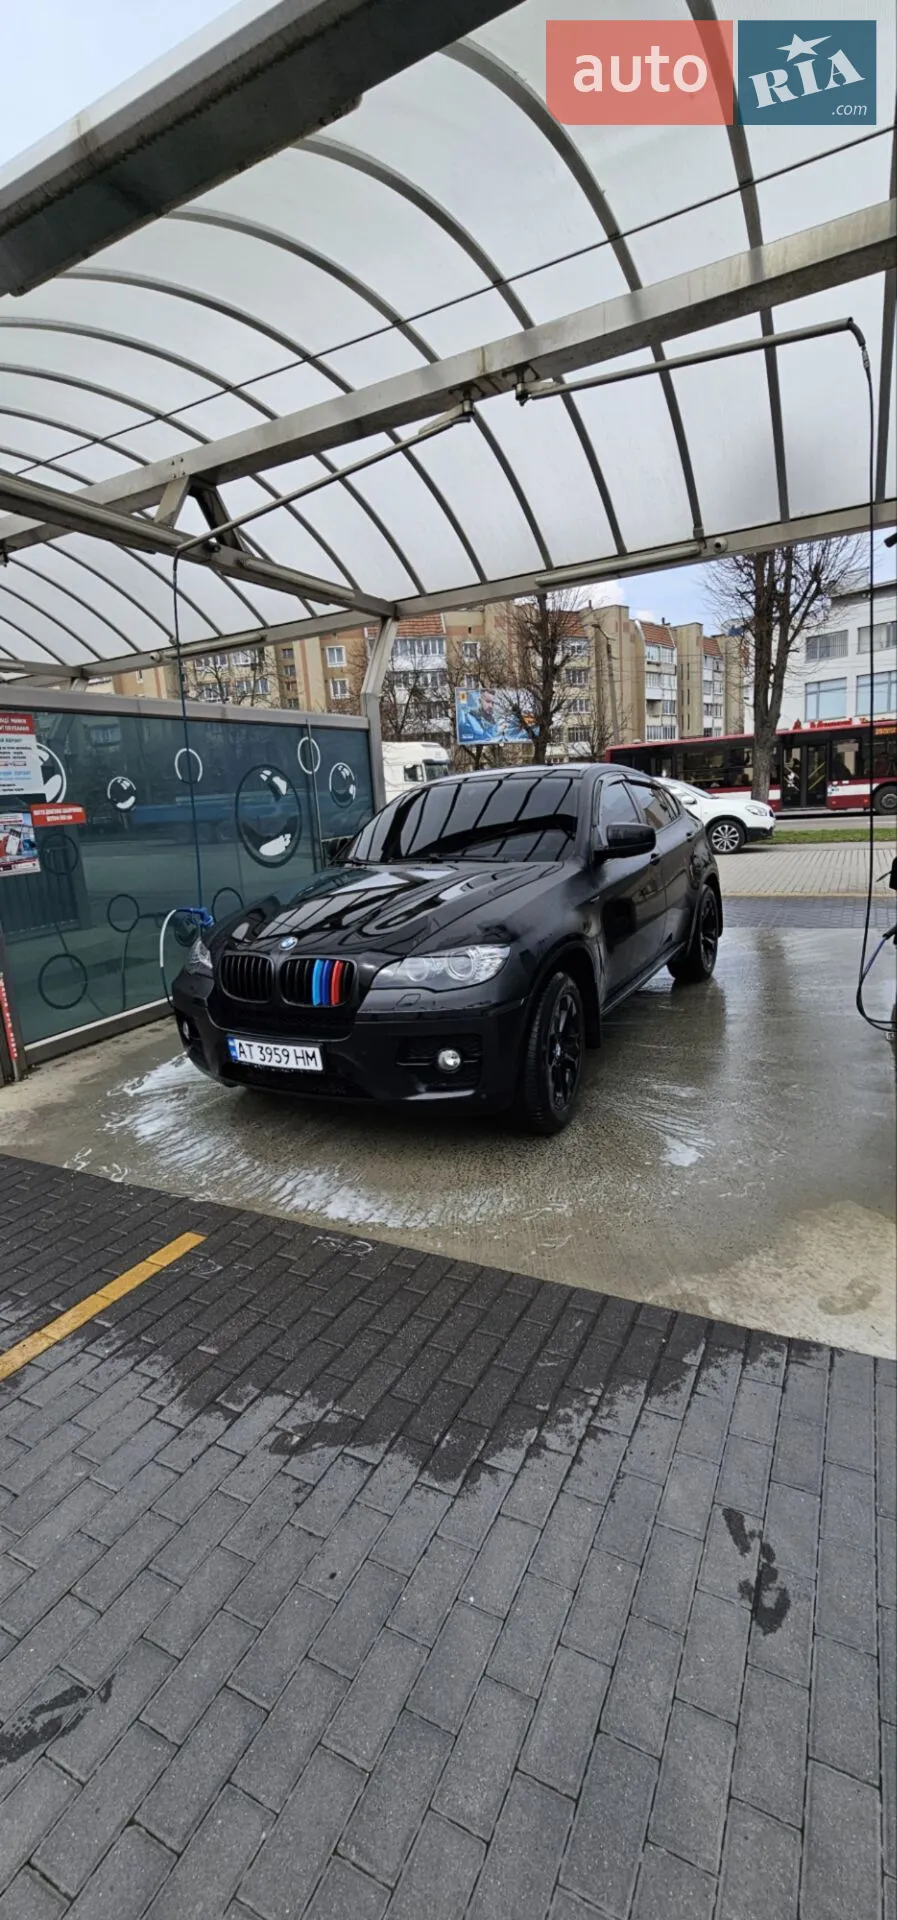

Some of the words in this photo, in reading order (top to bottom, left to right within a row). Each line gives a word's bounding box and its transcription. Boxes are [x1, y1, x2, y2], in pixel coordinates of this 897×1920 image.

[238, 1042, 254, 1060] AT
[257, 1045, 290, 1065] 3959
[293, 1049, 318, 1067] HM
